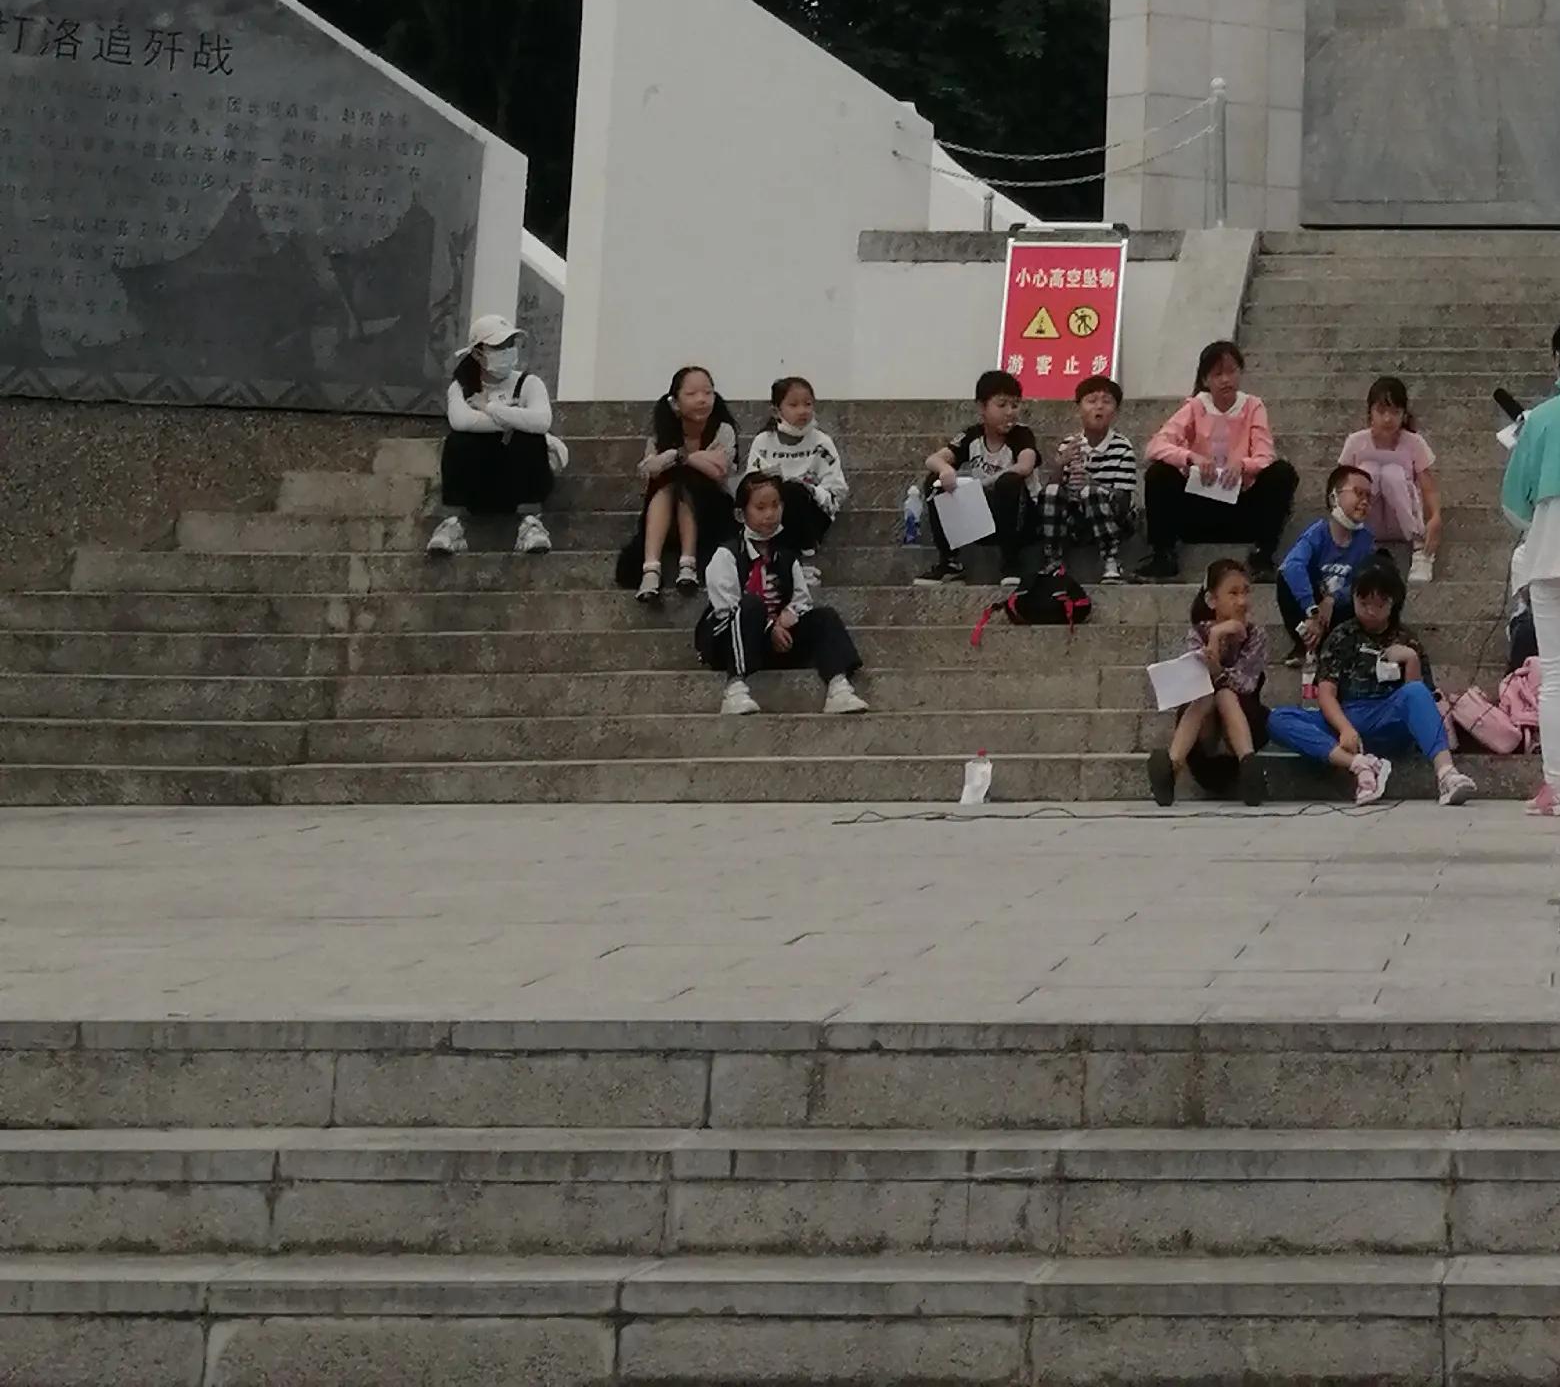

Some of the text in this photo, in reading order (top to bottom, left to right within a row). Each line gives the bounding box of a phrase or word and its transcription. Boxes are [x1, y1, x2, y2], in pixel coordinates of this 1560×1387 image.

[1015, 267, 1115, 289] 小心高空坠物
